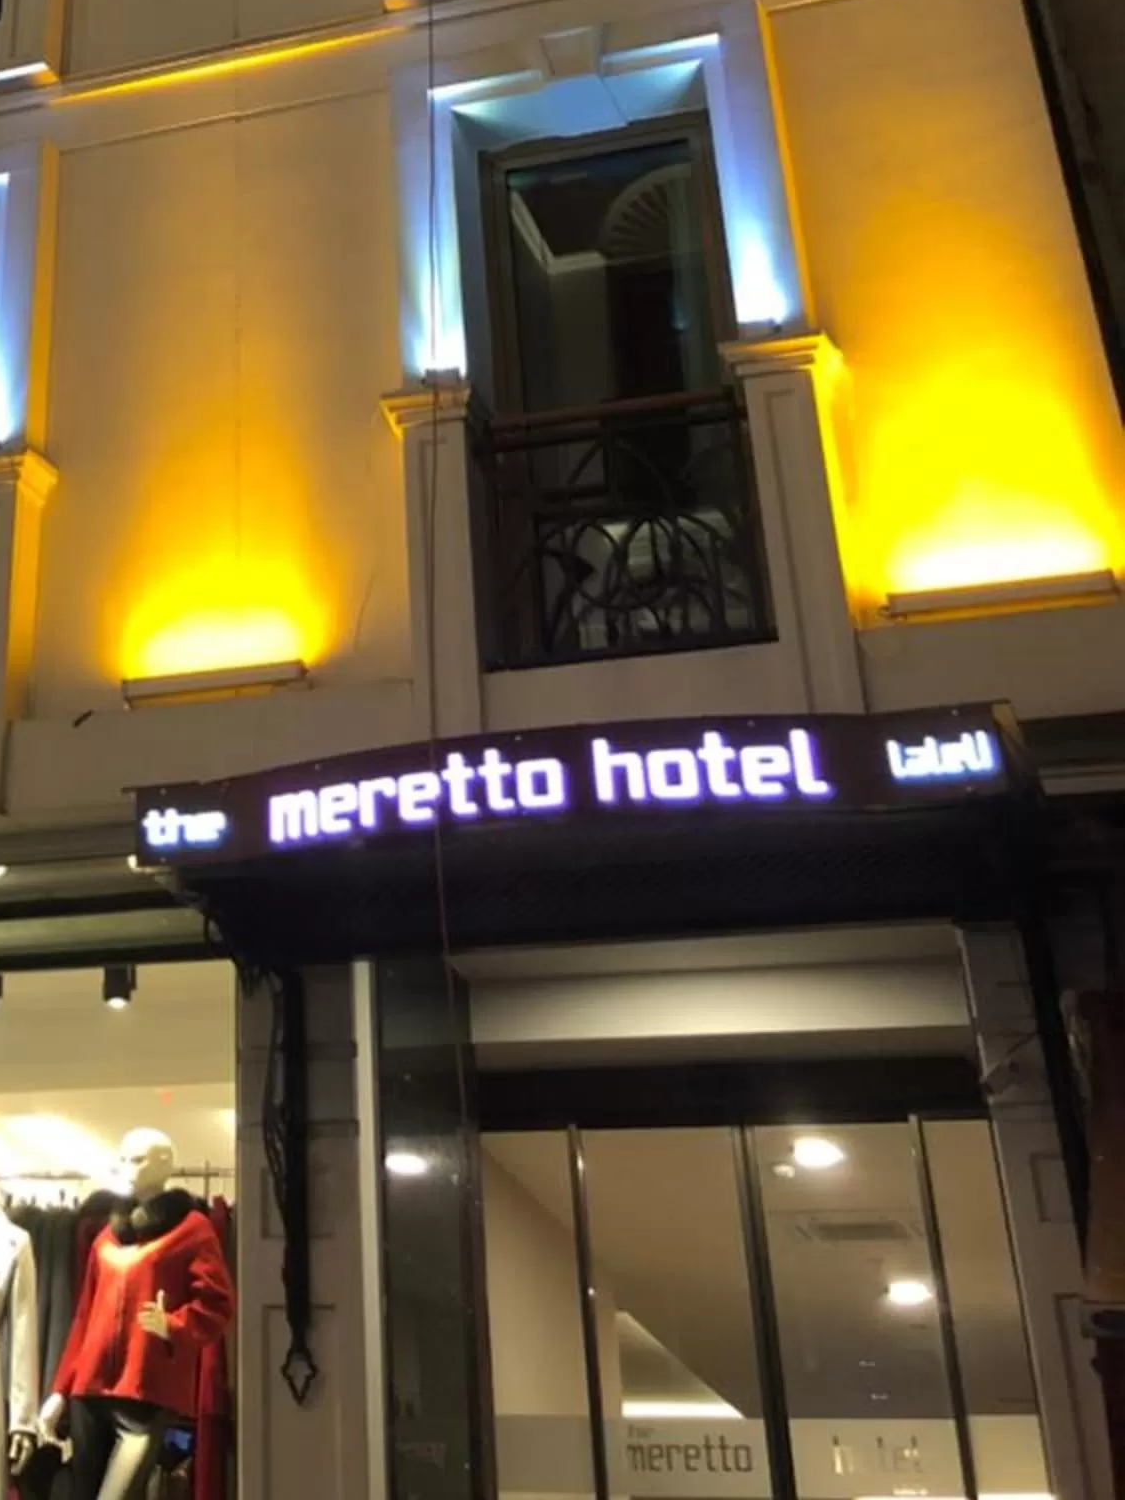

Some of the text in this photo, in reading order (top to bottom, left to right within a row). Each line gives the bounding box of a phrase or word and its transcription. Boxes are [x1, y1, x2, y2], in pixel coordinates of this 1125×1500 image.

[143, 808, 226, 846] the
[270, 749, 564, 843] meretto
[593, 729, 829, 801] hotel
[627, 1433, 754, 1473] meretto
